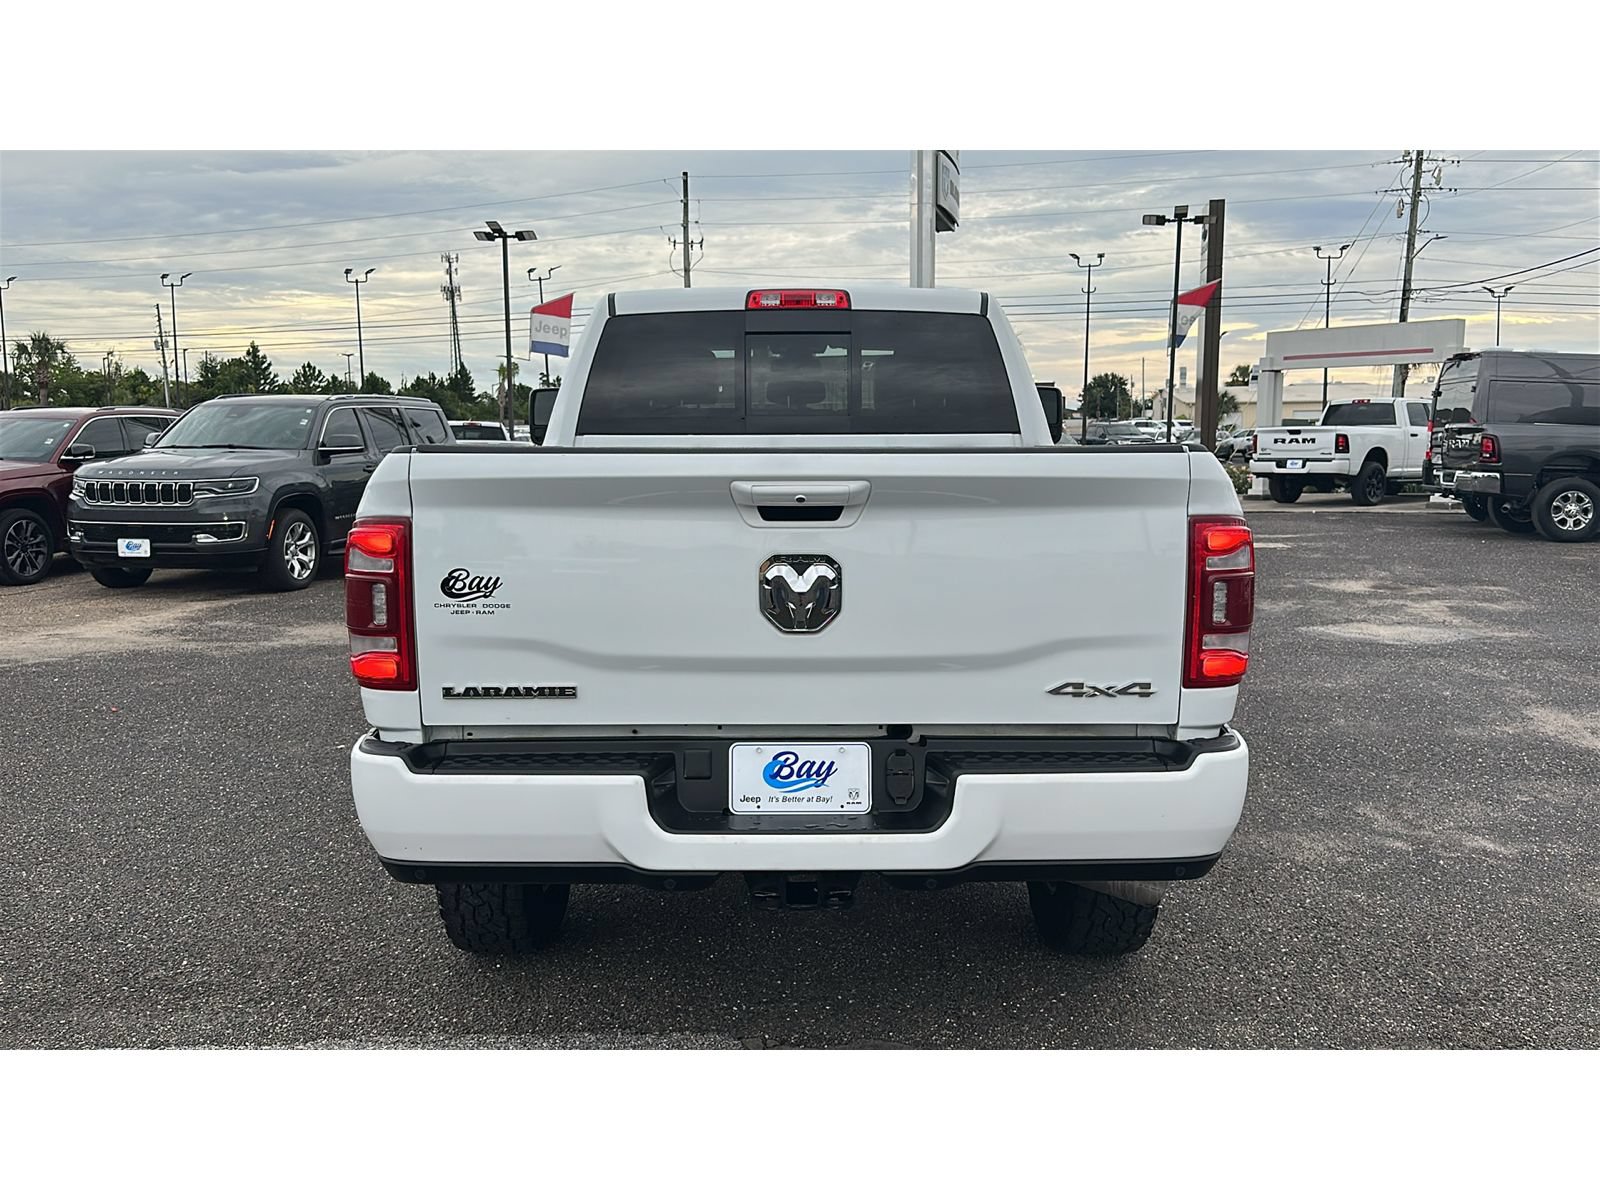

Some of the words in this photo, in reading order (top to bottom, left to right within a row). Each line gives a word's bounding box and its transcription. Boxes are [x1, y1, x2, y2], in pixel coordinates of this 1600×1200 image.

[534, 320, 568, 339] Jeep
[442, 568, 503, 600] Bay
[442, 686, 577, 699] LARAMIE
[1045, 682, 1158, 698] 4x4
[766, 751, 838, 789] Bay
[740, 795, 761, 804] Jeep
[815, 796, 833, 804] Bay!
